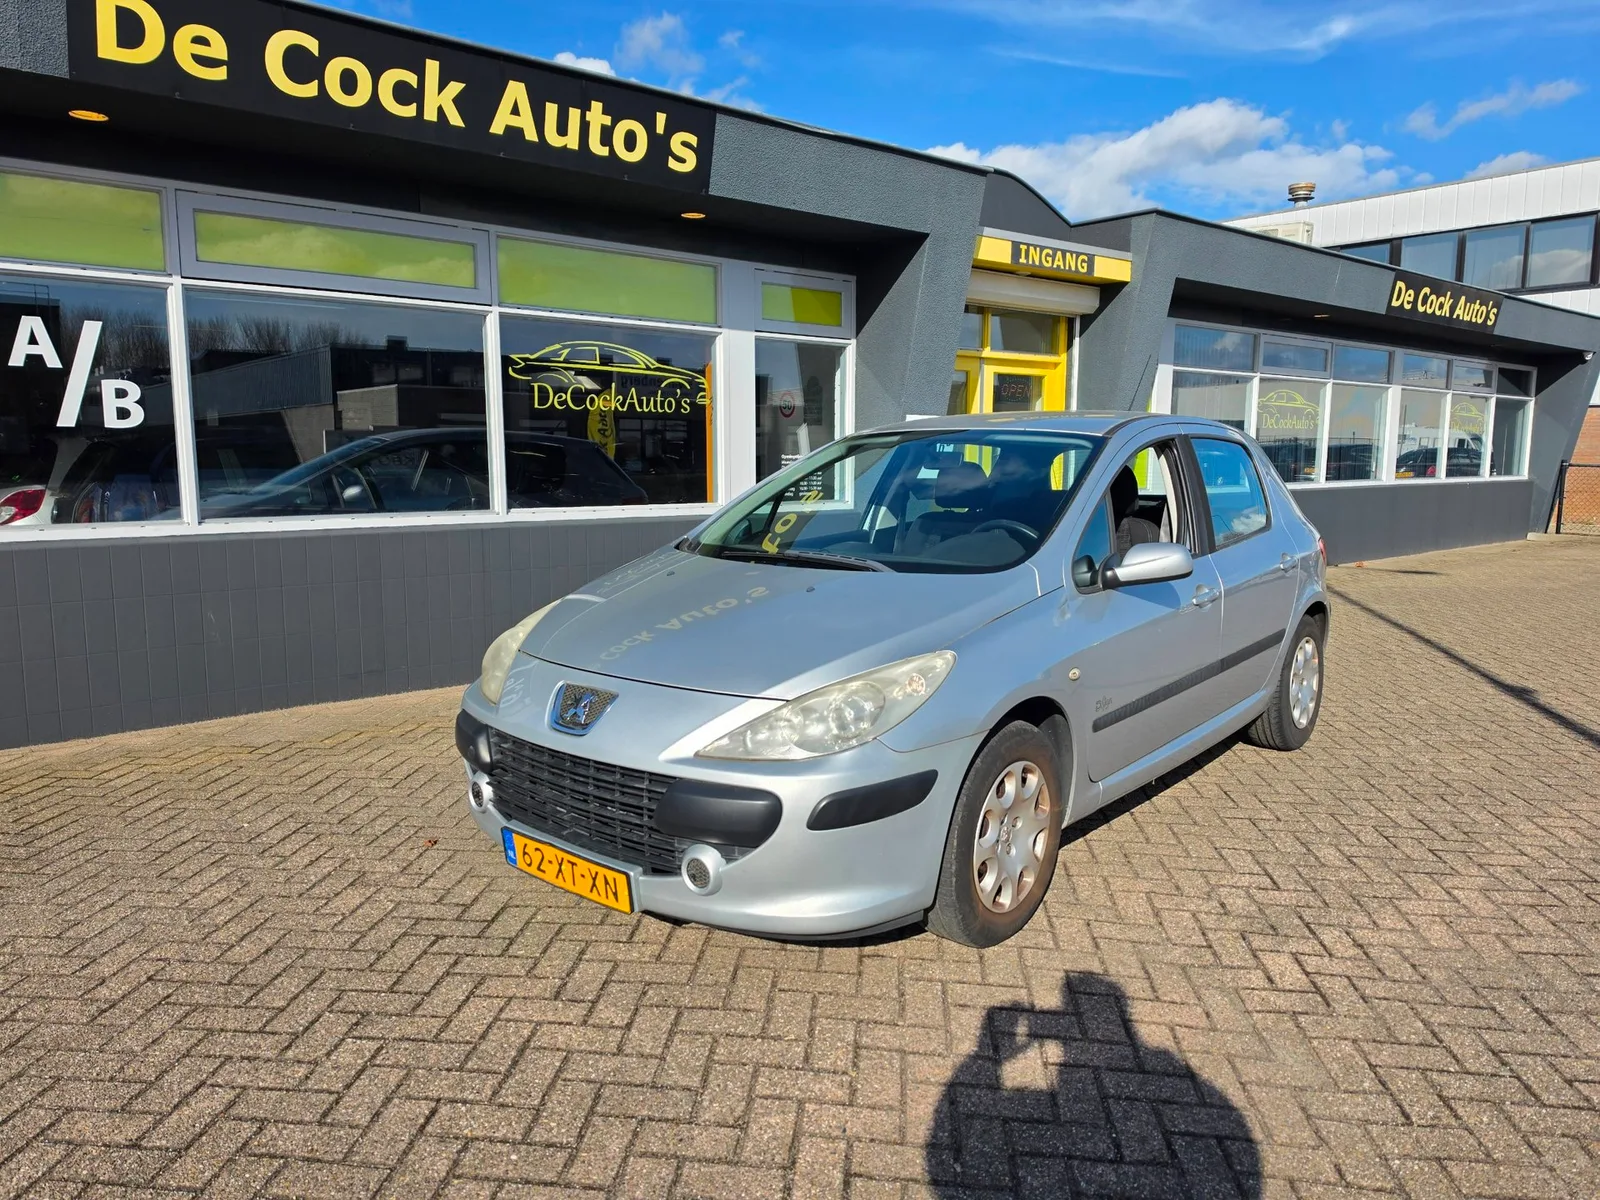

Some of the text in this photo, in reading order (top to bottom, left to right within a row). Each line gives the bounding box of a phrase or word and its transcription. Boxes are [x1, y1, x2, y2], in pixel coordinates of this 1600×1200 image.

[95, 0, 698, 173] De Cock Auto's
[1019, 244, 1088, 273] INGANG
[1391, 280, 1498, 326] De Cock Auto's
[530, 382, 691, 414] DeCockAuto's
[1001, 384, 1030, 397] OPEN
[1262, 412, 1315, 430] DeCockAuto's
[522, 843, 619, 903] 62-XT-XN
